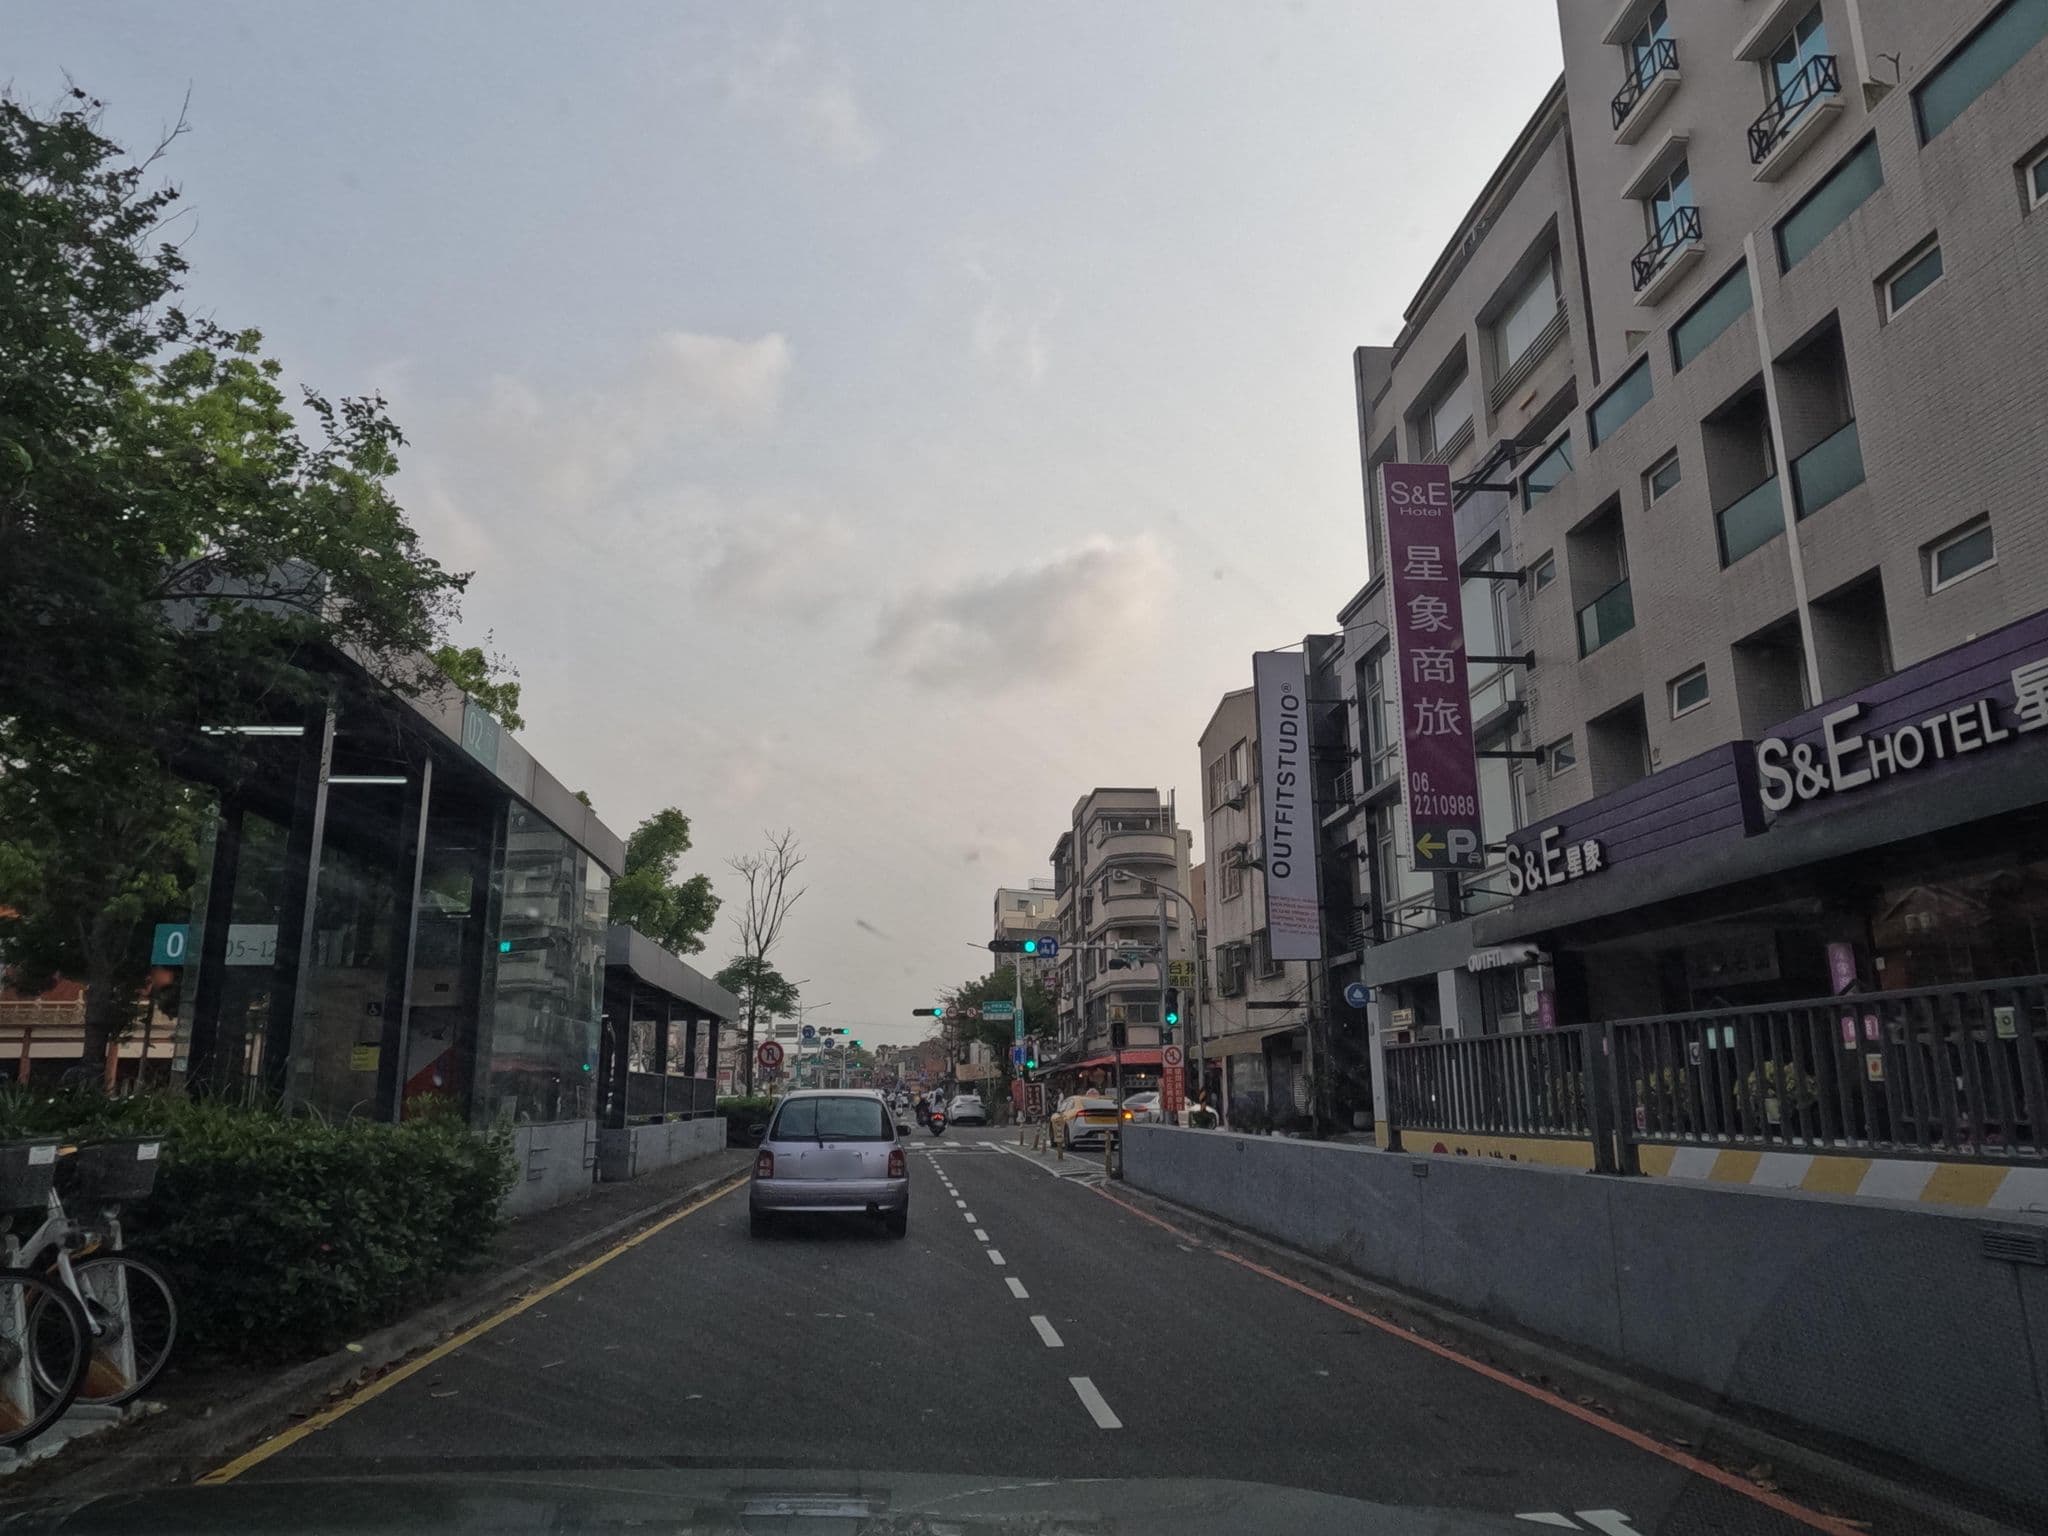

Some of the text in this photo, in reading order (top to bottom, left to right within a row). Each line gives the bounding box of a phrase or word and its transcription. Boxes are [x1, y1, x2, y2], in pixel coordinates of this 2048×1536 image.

[1391, 481, 1448, 506] S&E
[1400, 506, 1442, 517] Hotel
[1403, 545, 1463, 736] 星象商旅
[1758, 703, 1872, 811] S&E
[1867, 699, 2009, 779] HOTEL
[1415, 795, 1475, 816] 2210988
[1505, 826, 1565, 896] S&E
